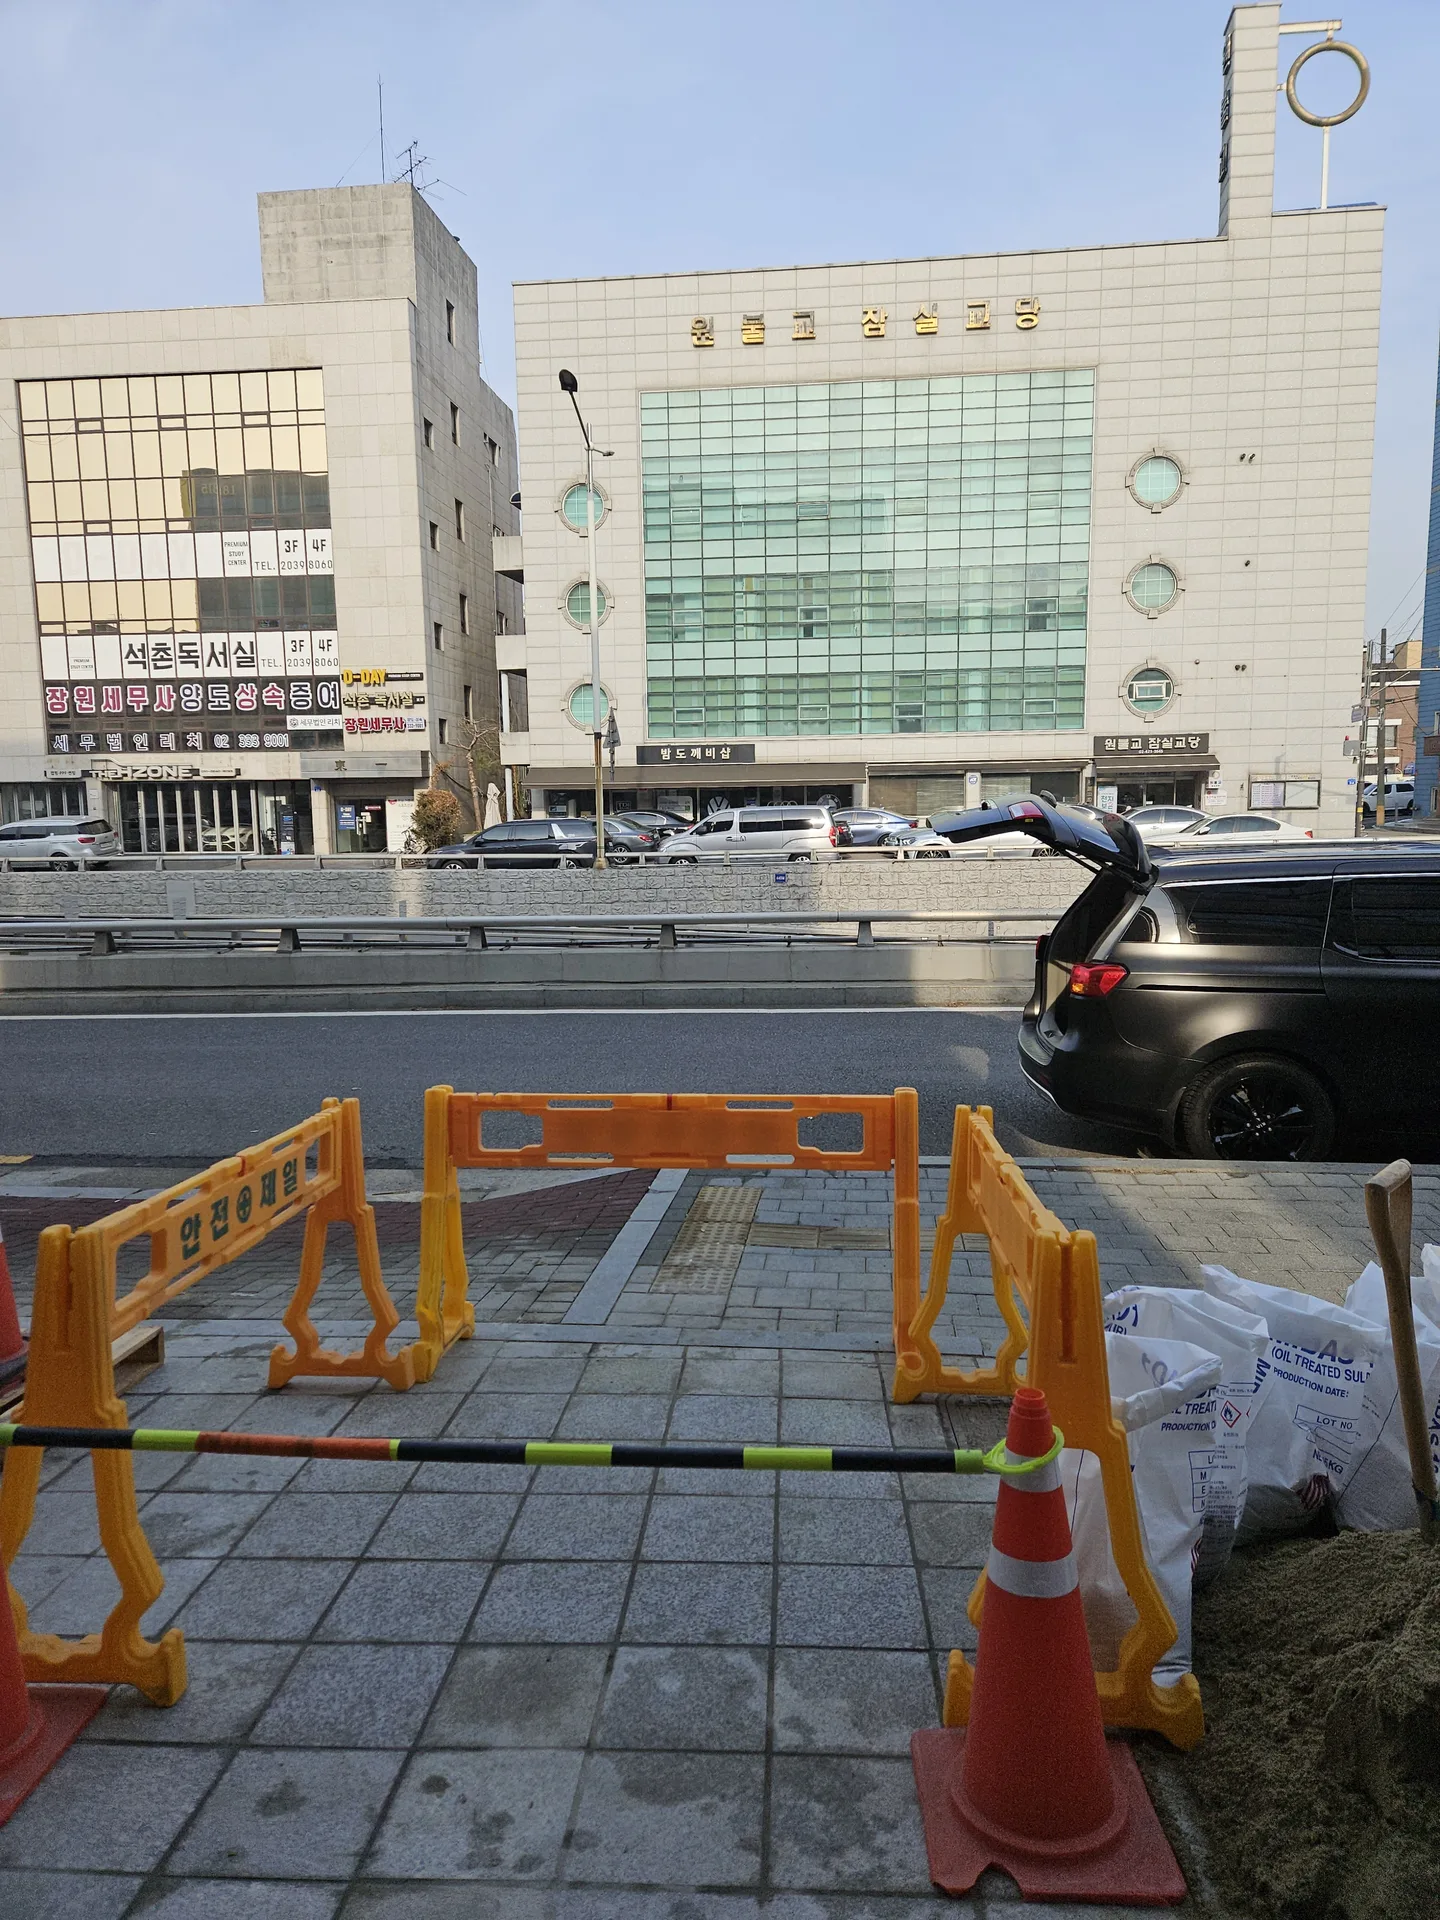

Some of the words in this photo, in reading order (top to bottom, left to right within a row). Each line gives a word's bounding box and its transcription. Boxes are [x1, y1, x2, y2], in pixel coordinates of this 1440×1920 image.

[690, 310, 817, 347] 원불교
[861, 295, 1042, 338] 잠실교당
[284, 539, 299, 553] 3F
[312, 538, 327, 552] 4F
[254, 561, 276, 571] TEL.
[280, 560, 305, 571] 2039
[308, 559, 333, 570] 8060
[290, 639, 305, 653] 3F
[318, 638, 333, 652] 4F
[261, 658, 282, 668] TEL.
[287, 657, 311, 668] 2039
[314, 657, 339, 667] 8060
[342, 668, 387, 684] D-DAY
[344, 716, 406, 732] 장원세무사
[213, 734, 230, 749] 02
[238, 733, 260, 748] 333
[263, 733, 290, 748] 9001
[1104, 737, 1143, 751] 원불교
[1148, 736, 1201, 750] 잠실교당
[179, 1196, 230, 1261] 안전
[259, 1156, 299, 1209] 제일
[1271, 1345, 1292, 1364] (OIL
[1295, 1353, 1341, 1380] TREATED
[1273, 1366, 1324, 1393] PRODUCTION
[1325, 1385, 1349, 1399] DATE:
[1160, 1420, 1211, 1433] PRODUCTION
[1316, 1415, 1337, 1428] LOT
[1340, 1418, 1353, 1430] NO
